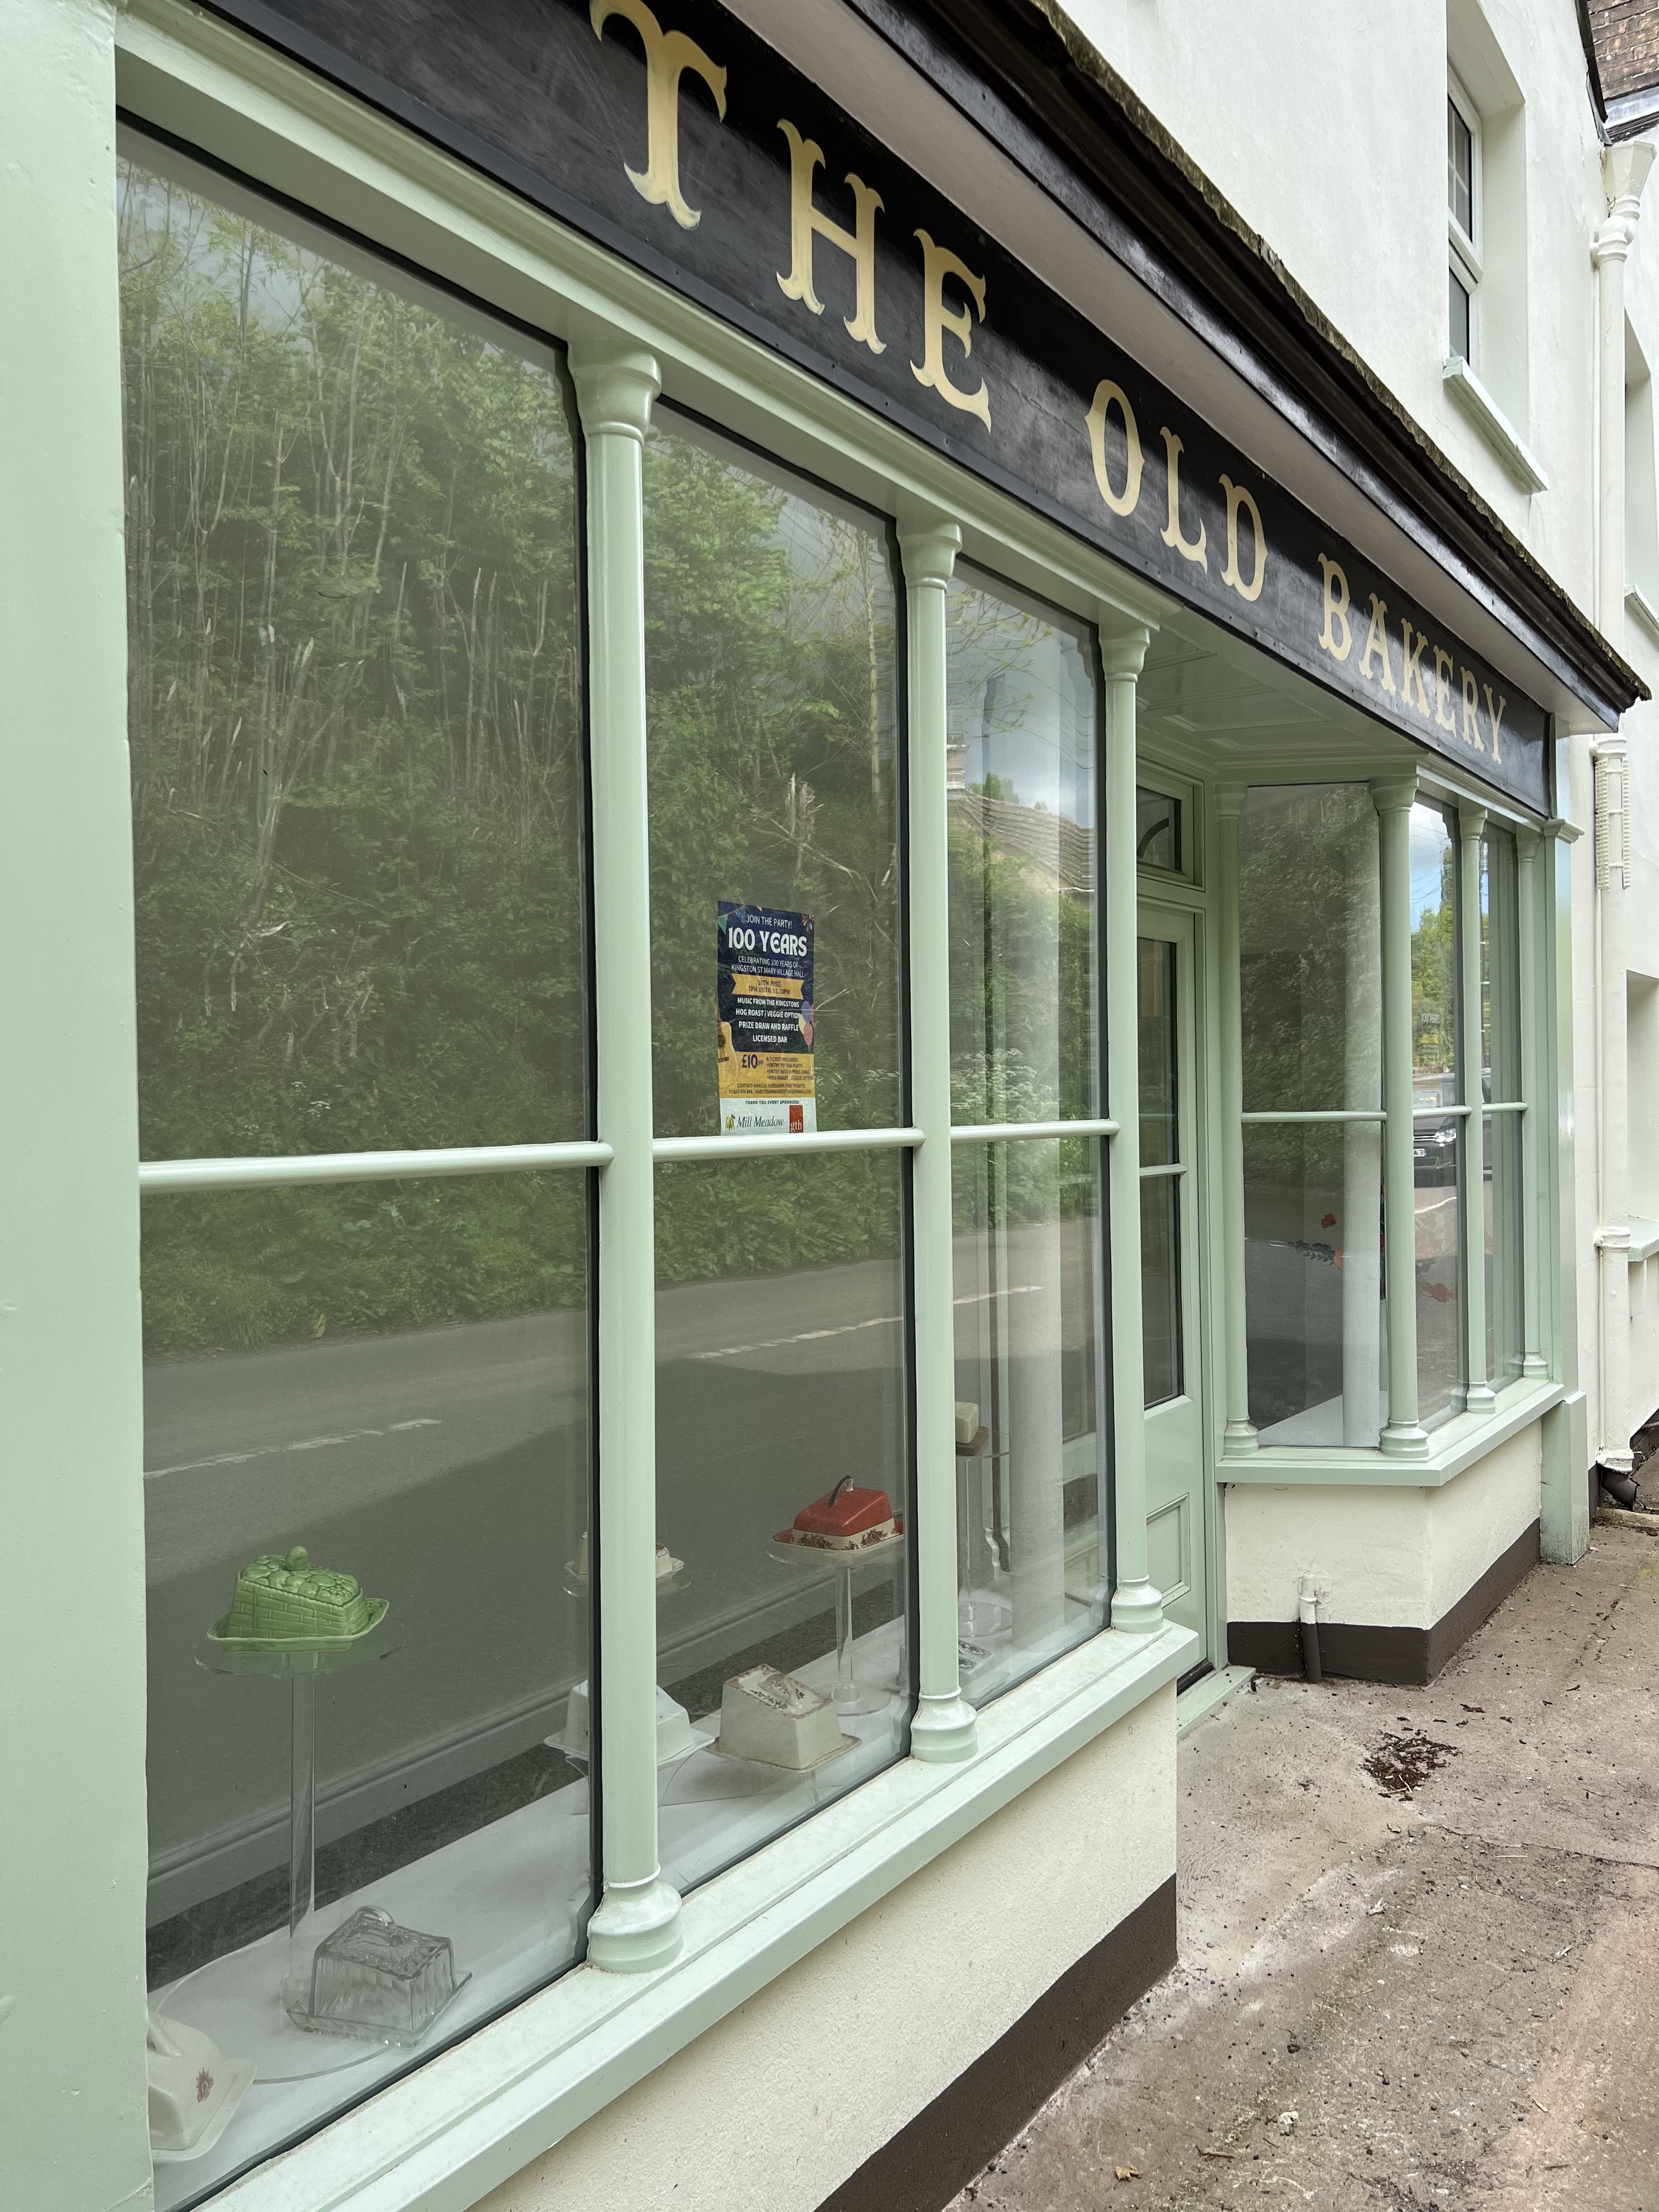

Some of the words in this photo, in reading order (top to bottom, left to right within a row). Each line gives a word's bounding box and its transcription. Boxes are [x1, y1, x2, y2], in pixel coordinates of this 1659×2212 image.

[589, 0, 991, 435] THE
[1085, 379, 1268, 602] OLD
[1317, 552, 1506, 765] BAKERY
[747, 915, 760, 924] JOIN
[761, 916, 772, 926] THE
[774, 918, 792, 929] PARTY!
[728, 927, 755, 950] 100
[759, 930, 807, 957] YEARS
[738, 955, 770, 966] CELEBRATING
[779, 960, 792, 968] YEARS
[731, 964, 757, 973] KINGSTON
[776, 968, 794, 977] VILLAGE
[776, 1000, 799, 1008] KINGSTONS
[755, 1022, 770, 1030] DRAW
[782, 1023, 799, 1031] RAFFLE
[742, 1054, 758, 1069] £10
[737, 1116, 753, 1128] Mill
[753, 1115, 784, 1127] Meadow
[790, 1119, 802, 1133] gth
